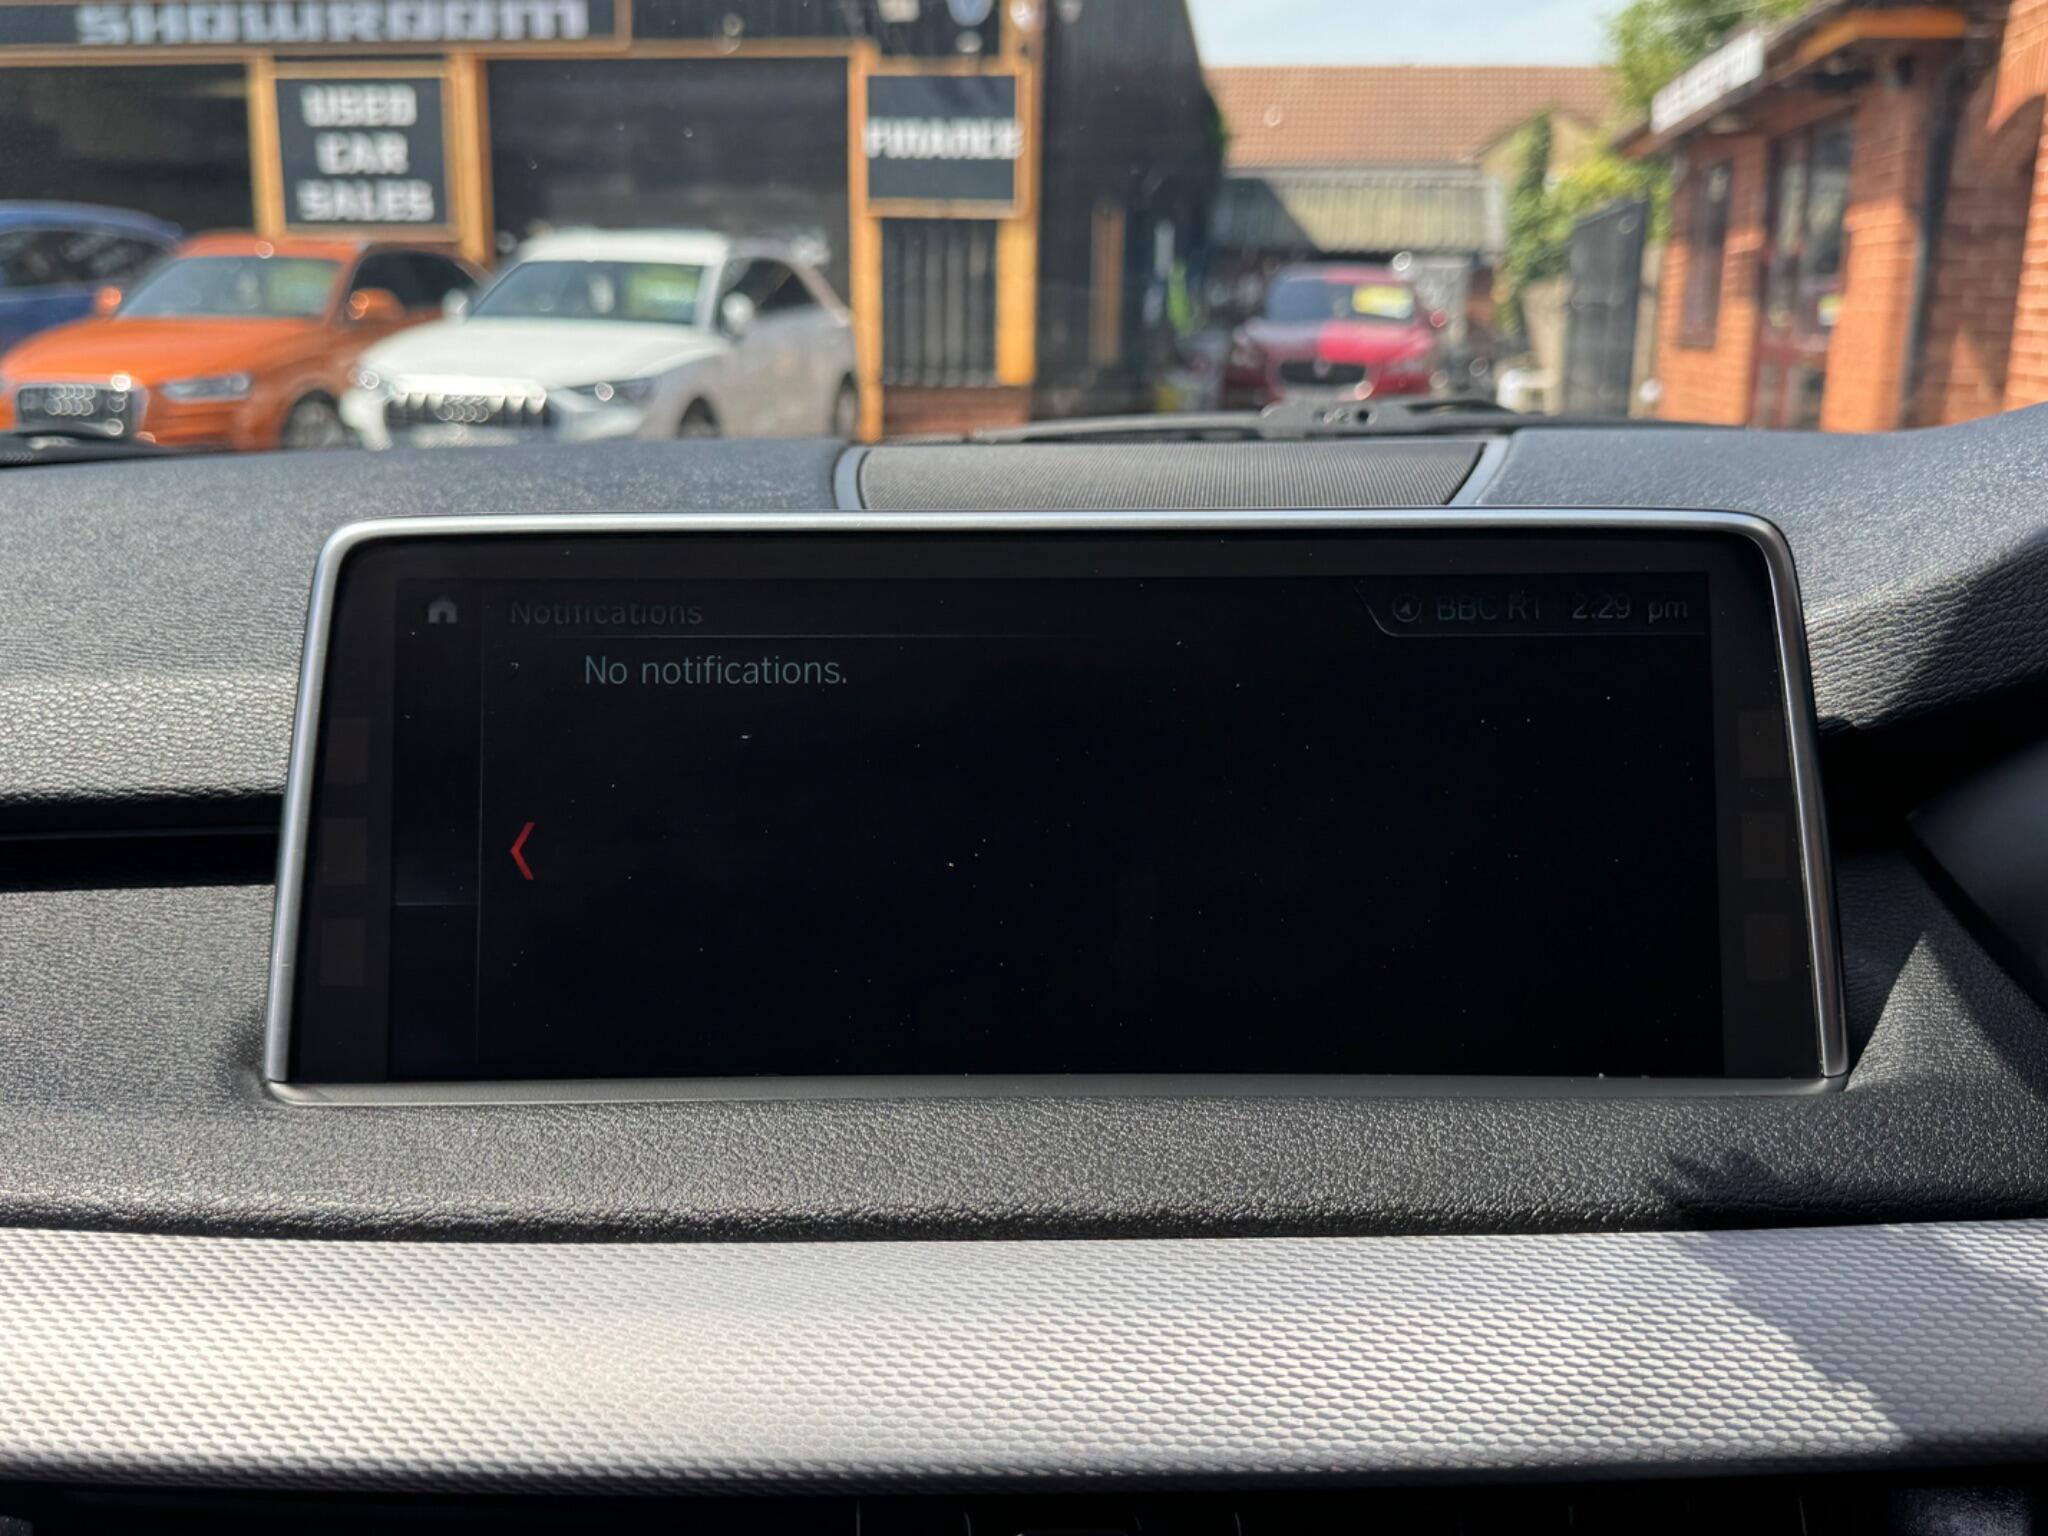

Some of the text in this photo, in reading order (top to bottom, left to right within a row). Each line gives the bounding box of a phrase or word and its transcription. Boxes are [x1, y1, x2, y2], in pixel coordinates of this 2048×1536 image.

[302, 86, 416, 127] USED
[316, 134, 410, 175] CAR
[864, 117, 1023, 160] FINANCE
[297, 180, 434, 221] SALES
[509, 599, 703, 625] Notifications
[1436, 594, 1497, 621] BBC
[1648, 598, 1689, 624] pm
[583, 653, 848, 686] No notifications.
